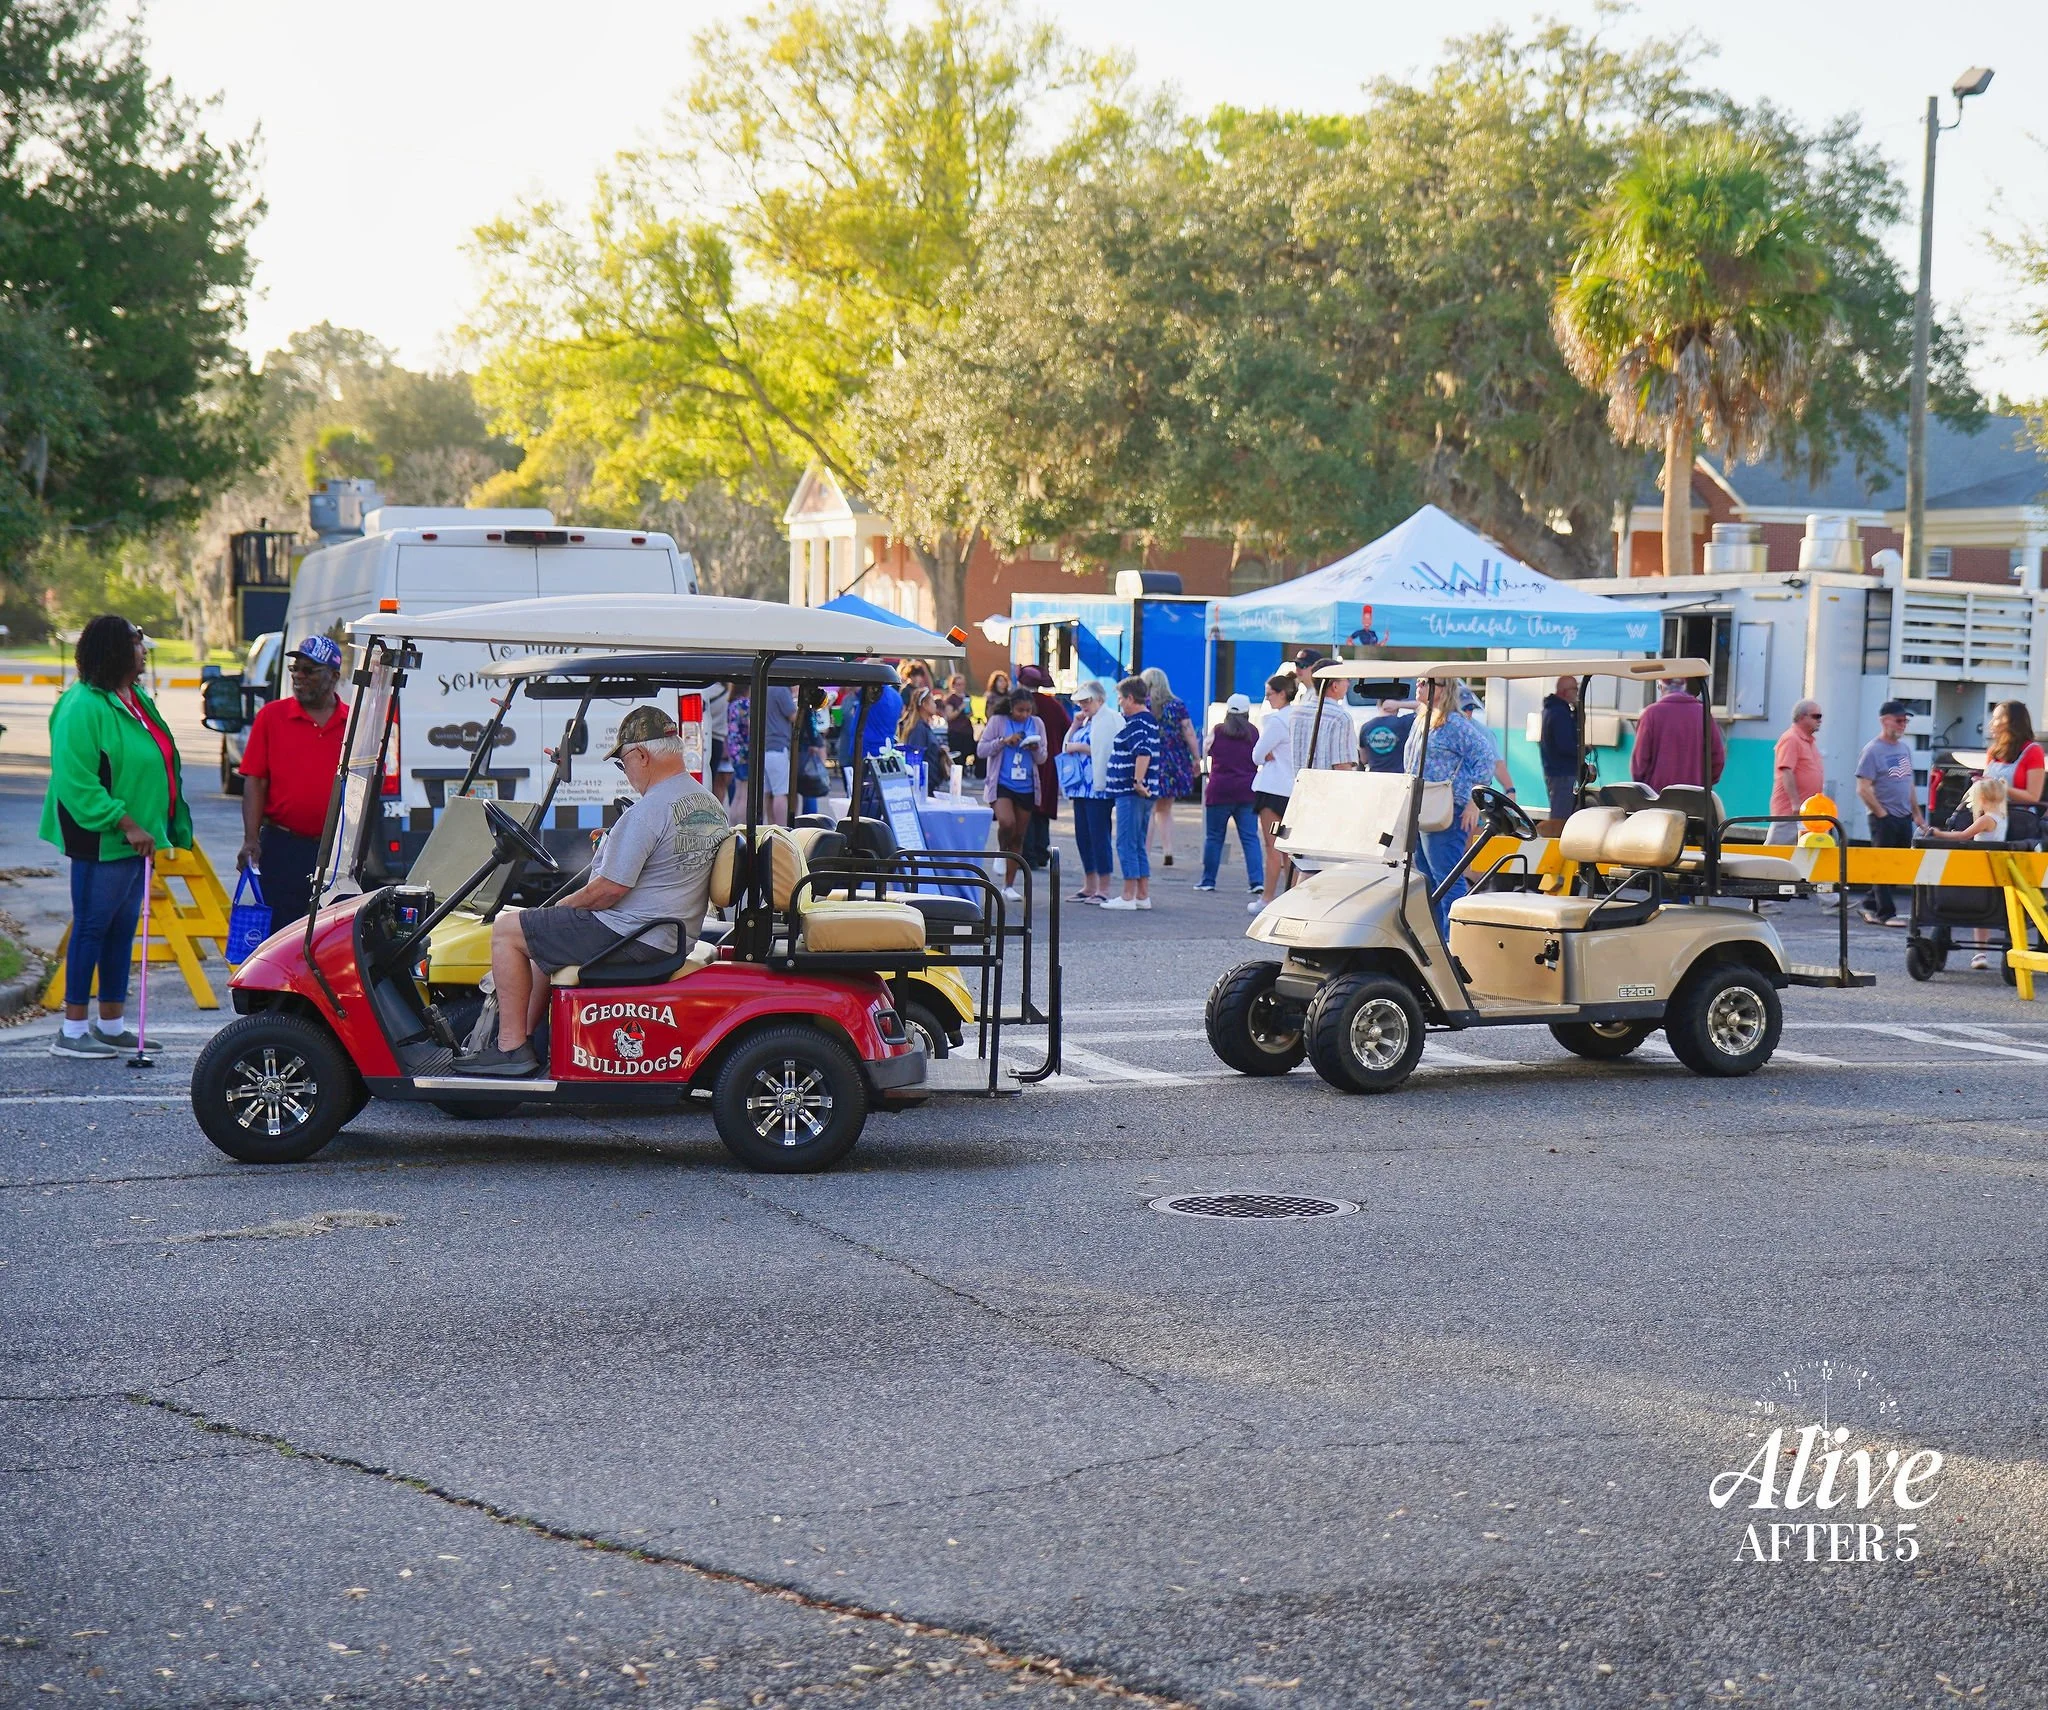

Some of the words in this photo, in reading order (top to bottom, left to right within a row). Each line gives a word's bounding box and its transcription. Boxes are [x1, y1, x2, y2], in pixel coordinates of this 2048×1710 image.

[1421, 611, 1516, 639] Wandaful
[1520, 613, 1580, 647] Things
[580, 1003, 678, 1028] GEORGIA
[572, 1044, 683, 1076] BULLDOGS
